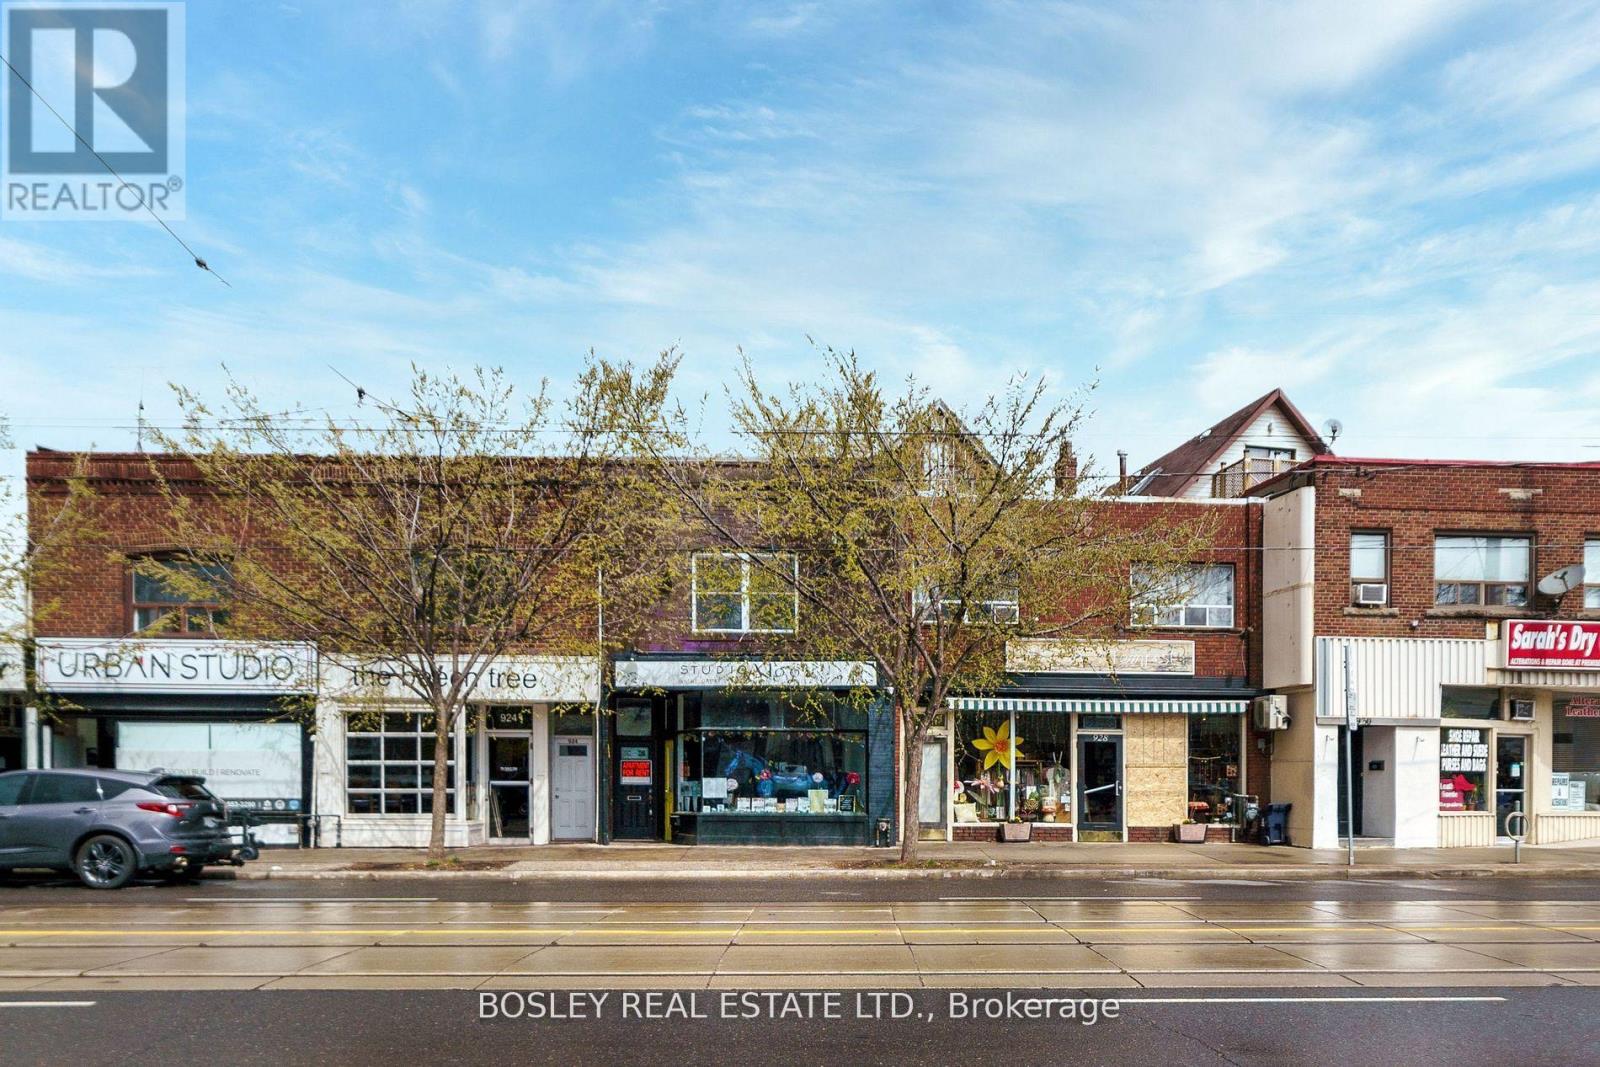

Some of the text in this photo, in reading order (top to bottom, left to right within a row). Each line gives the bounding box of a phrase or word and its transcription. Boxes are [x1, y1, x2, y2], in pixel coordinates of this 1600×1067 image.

[1511, 623, 1598, 657] Sarah's Dry
[58, 652, 293, 680] URBAN STUDIO
[680, 664, 747, 675] STUDIO
[353, 665, 391, 687] the
[489, 668, 537, 689] tree
[1462, 744, 1473, 757] AND
[1461, 758, 1472, 771] AND
[192, 768, 215, 776] BUILD
[220, 768, 262, 776] RENOVATE
